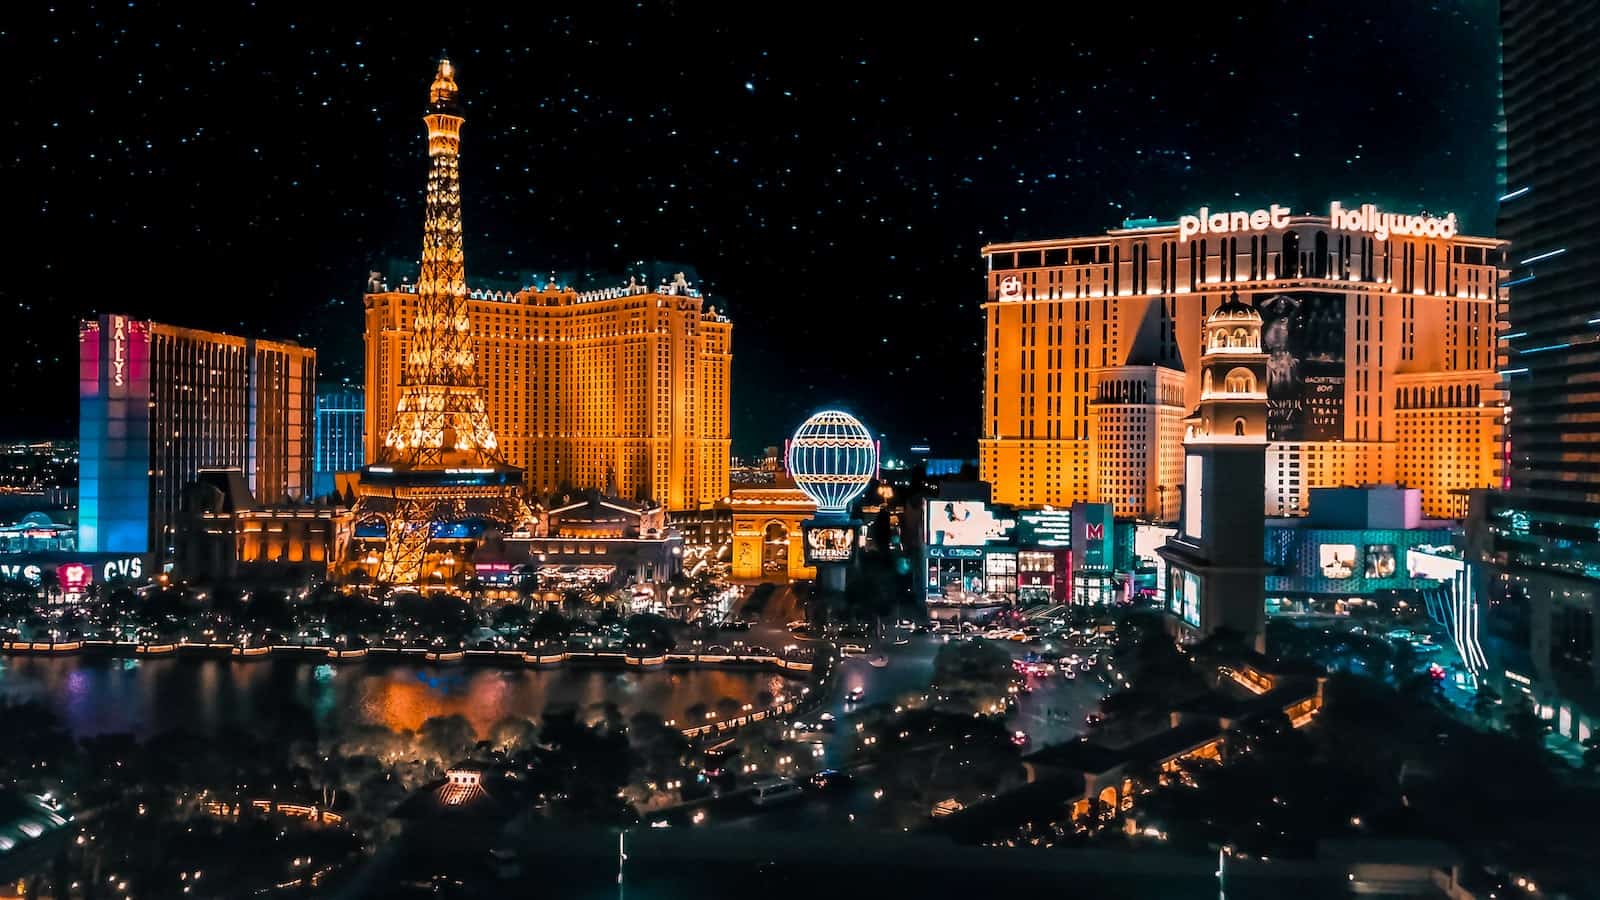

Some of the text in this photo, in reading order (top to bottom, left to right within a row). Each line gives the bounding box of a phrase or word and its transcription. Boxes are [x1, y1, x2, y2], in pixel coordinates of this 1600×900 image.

[1179, 201, 1458, 243] planet hollywood
[0, 565, 41, 587] VS
[103, 557, 142, 581] CVS
